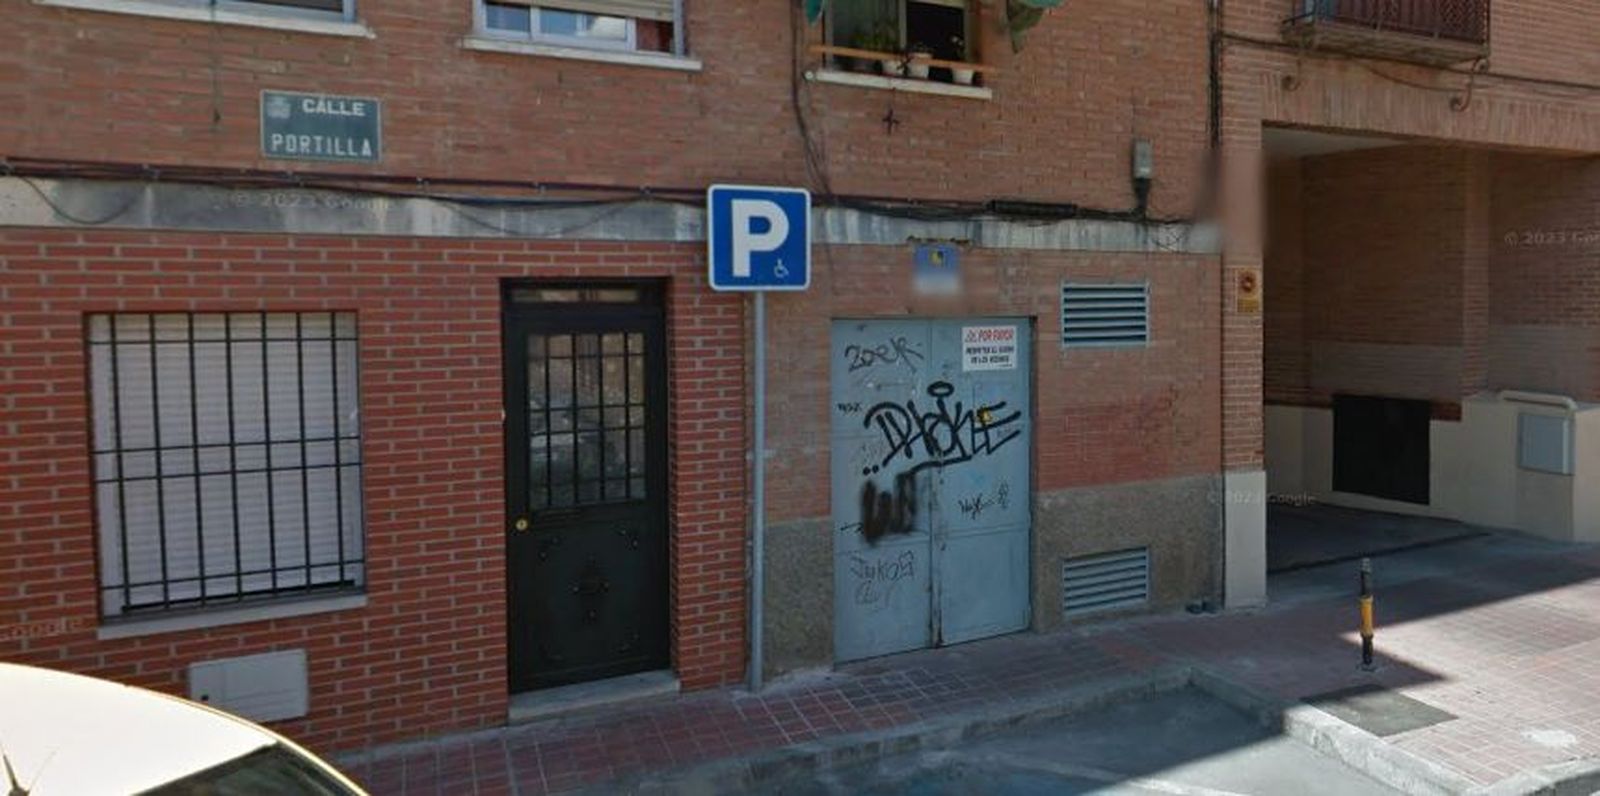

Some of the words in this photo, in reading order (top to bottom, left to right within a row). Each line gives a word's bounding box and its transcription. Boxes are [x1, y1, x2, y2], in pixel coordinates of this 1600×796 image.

[302, 98, 365, 116] CALLE
[271, 133, 373, 156] PORTILLA
[731, 199, 790, 277] P
